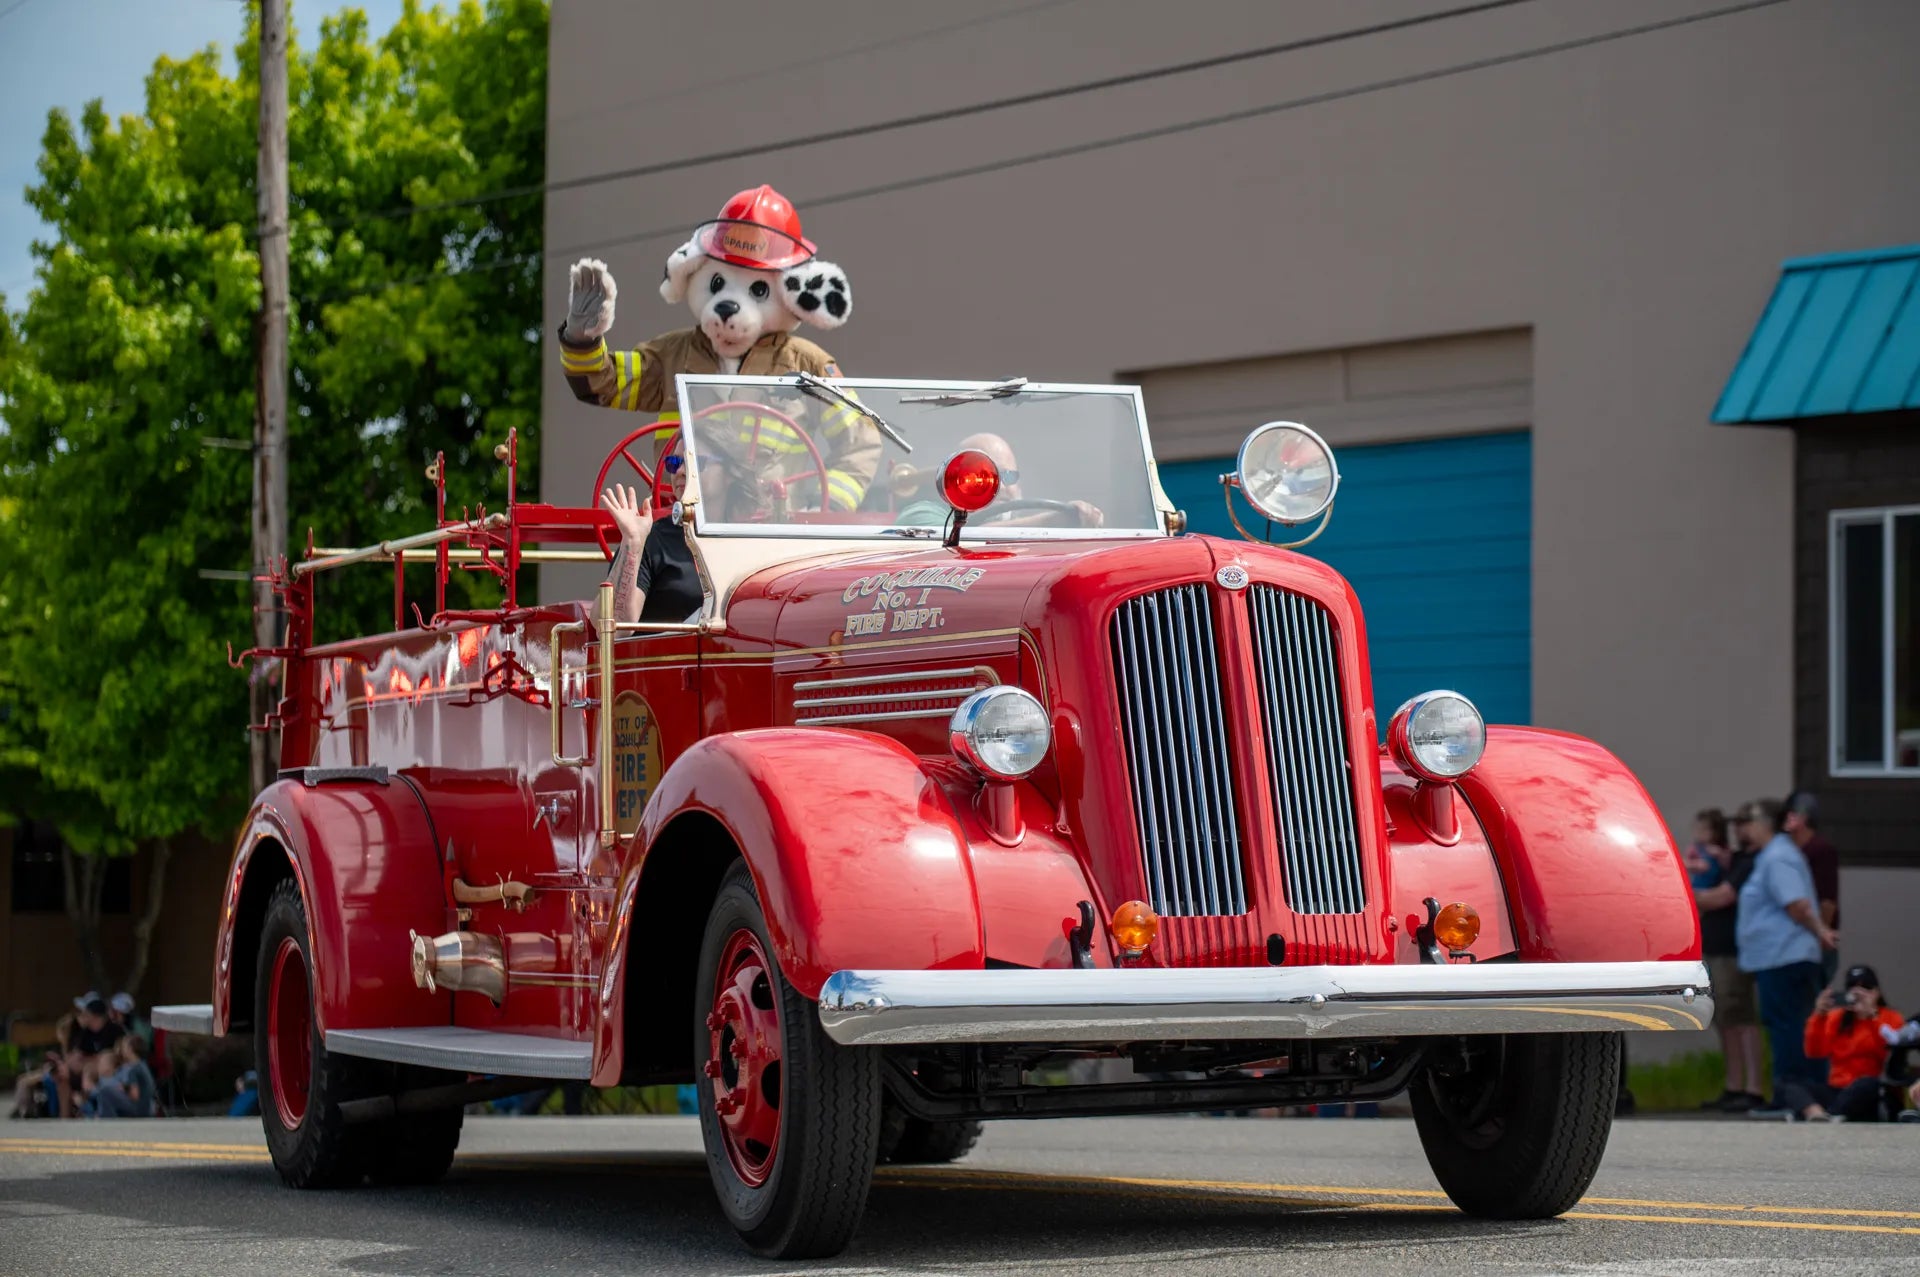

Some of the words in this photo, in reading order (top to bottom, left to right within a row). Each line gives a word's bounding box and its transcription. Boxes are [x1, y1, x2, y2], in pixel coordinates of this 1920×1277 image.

[724, 236, 766, 252] SPARKY
[843, 567, 986, 603] COQUILLE
[871, 591, 911, 611] NO.
[843, 612, 886, 637] FIRE
[890, 608, 945, 633] DEPT.
[616, 718, 629, 730] ITY
[635, 716, 647, 730] OF
[616, 789, 648, 819] EPT
